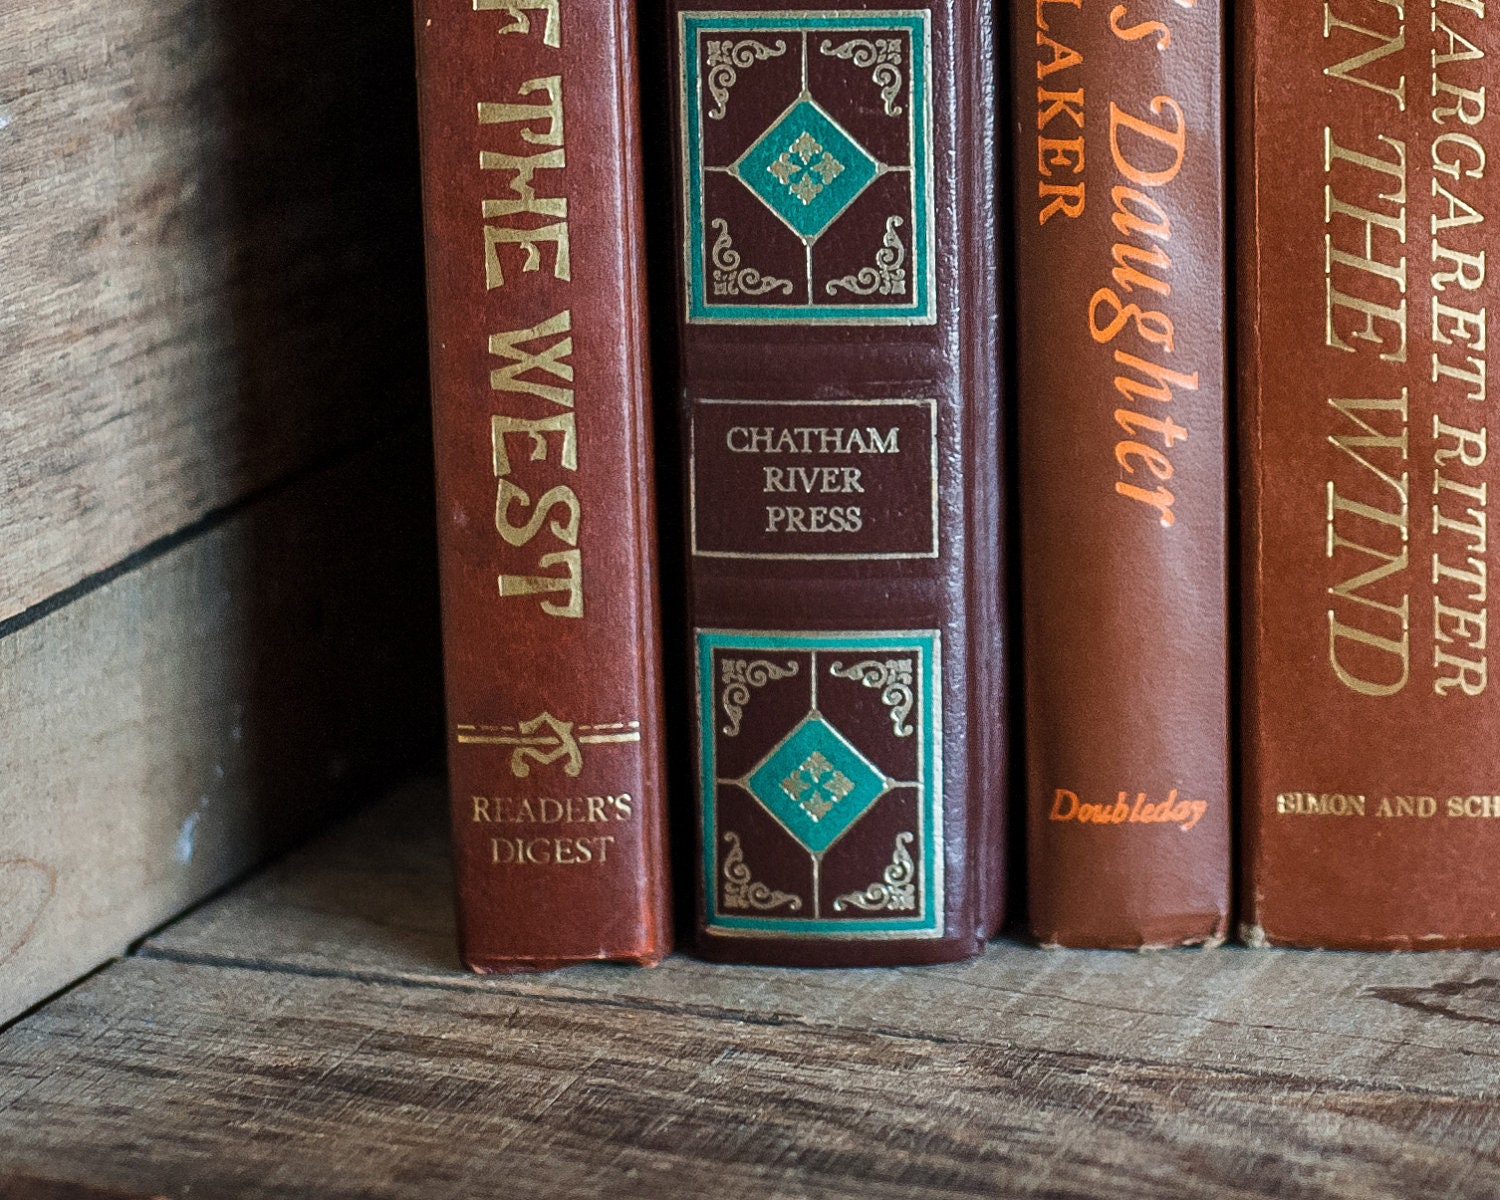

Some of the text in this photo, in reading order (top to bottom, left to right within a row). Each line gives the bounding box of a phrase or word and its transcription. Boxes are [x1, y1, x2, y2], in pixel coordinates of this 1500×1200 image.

[476, 74, 572, 292] THE
[1323, 125, 1408, 364] THE
[1088, 95, 1199, 529] Daughter
[725, 425, 901, 453] CHATHAM
[487, 309, 585, 620] WEST
[762, 466, 866, 493] RIVER
[765, 506, 863, 533] PRESS
[1325, 386, 1410, 698] WIND
[1431, 413, 1489, 698] RITTER
[471, 793, 633, 824] READER'S
[1049, 787, 1208, 831] Doubleday
[1275, 791, 1366, 815] SIMON
[1374, 794, 1437, 818] AND
[490, 835, 616, 866] DIGEST
